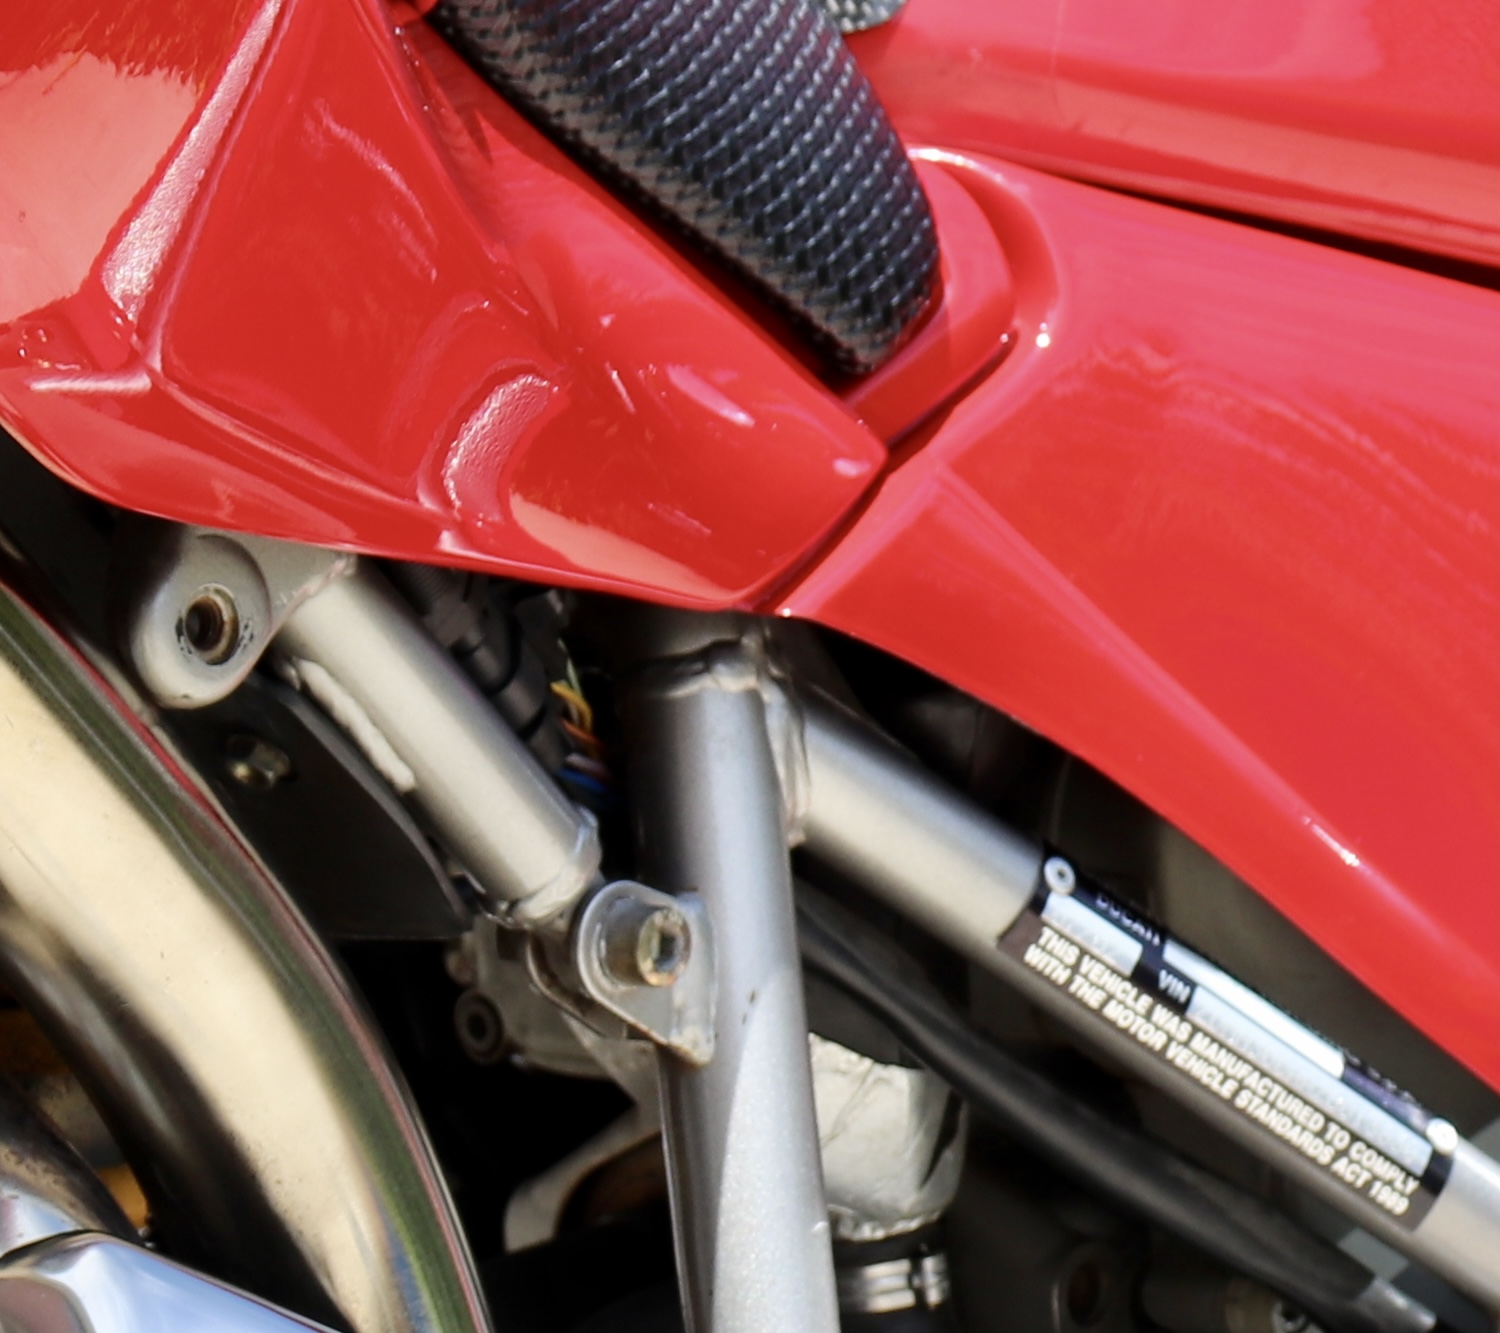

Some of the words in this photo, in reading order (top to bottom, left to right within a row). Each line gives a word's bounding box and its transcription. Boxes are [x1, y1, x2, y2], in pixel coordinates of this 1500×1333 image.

[1020, 943, 1073, 988] WITH
[1065, 974, 1108, 1012] THE
[1101, 998, 1168, 1052] MOTOR
[1163, 1039, 1239, 1100] VEHICLE
[1232, 1086, 1337, 1166] STANDARDS
[1330, 1152, 1373, 1191] ACT
[1366, 1177, 1412, 1218] 1989
[1034, 927, 1082, 968] THIS
[1076, 955, 1153, 1016] VEHICLE
[1148, 1004, 1194, 1044] WAS
[1187, 1031, 1327, 1134] MANUFACTURED
[1321, 1121, 1353, 1152] TO
[1347, 1139, 1421, 1197] COMPLY
[1152, 968, 1193, 1005] VIN
